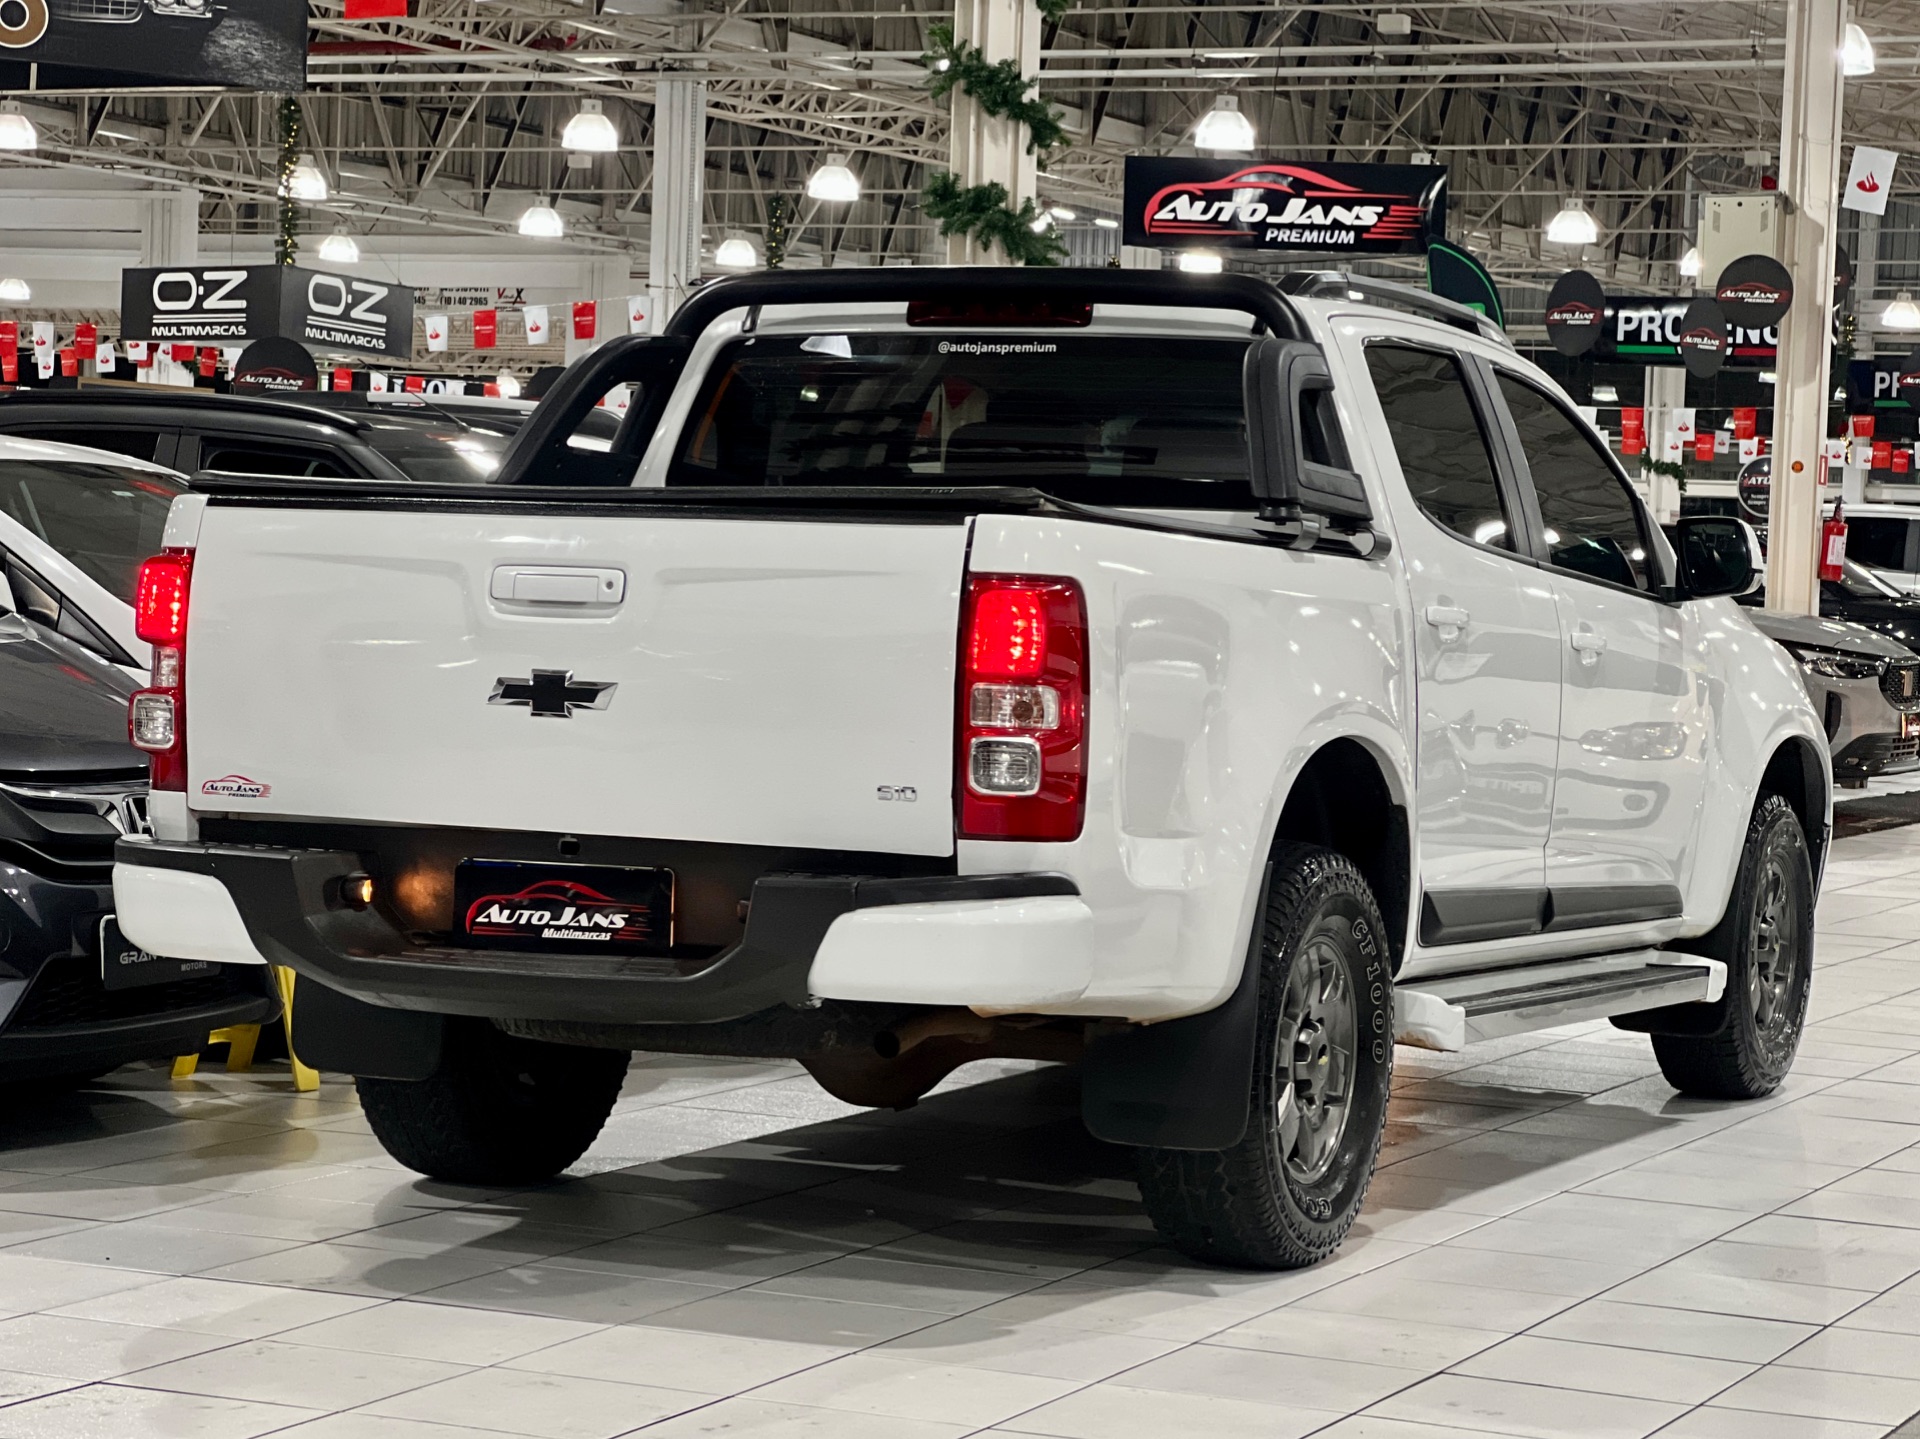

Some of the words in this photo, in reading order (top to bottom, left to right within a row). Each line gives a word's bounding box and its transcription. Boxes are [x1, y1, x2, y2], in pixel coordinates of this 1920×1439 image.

[1153, 194, 1269, 223] AUTO
[1265, 198, 1384, 227] JANS
[1265, 228, 1355, 244] PREMIUM
[1721, 289, 1749, 298] AUTO
[1747, 290, 1781, 299] JANS
[1550, 311, 1572, 319] AUTO
[1571, 312, 1595, 320] JANS
[151, 325, 247, 337] MULTIMARCAS
[305, 327, 386, 350] MULTIMARCAS
[1683, 335, 1702, 344] AUTO
[1701, 336, 1720, 346] JANS
[938, 341, 1057, 355] @autojanspremium
[240, 374, 272, 384] AUTO
[270, 376, 305, 386] JANS
[232, 785, 261, 793] JANS
[877, 785, 917, 802] S10
[475, 904, 551, 925] AUTO
[549, 906, 629, 929] JANS
[541, 928, 612, 940] Multimarcas
[181, 961, 208, 971] MOTORS
[1352, 919, 1385, 1064] CF1000
